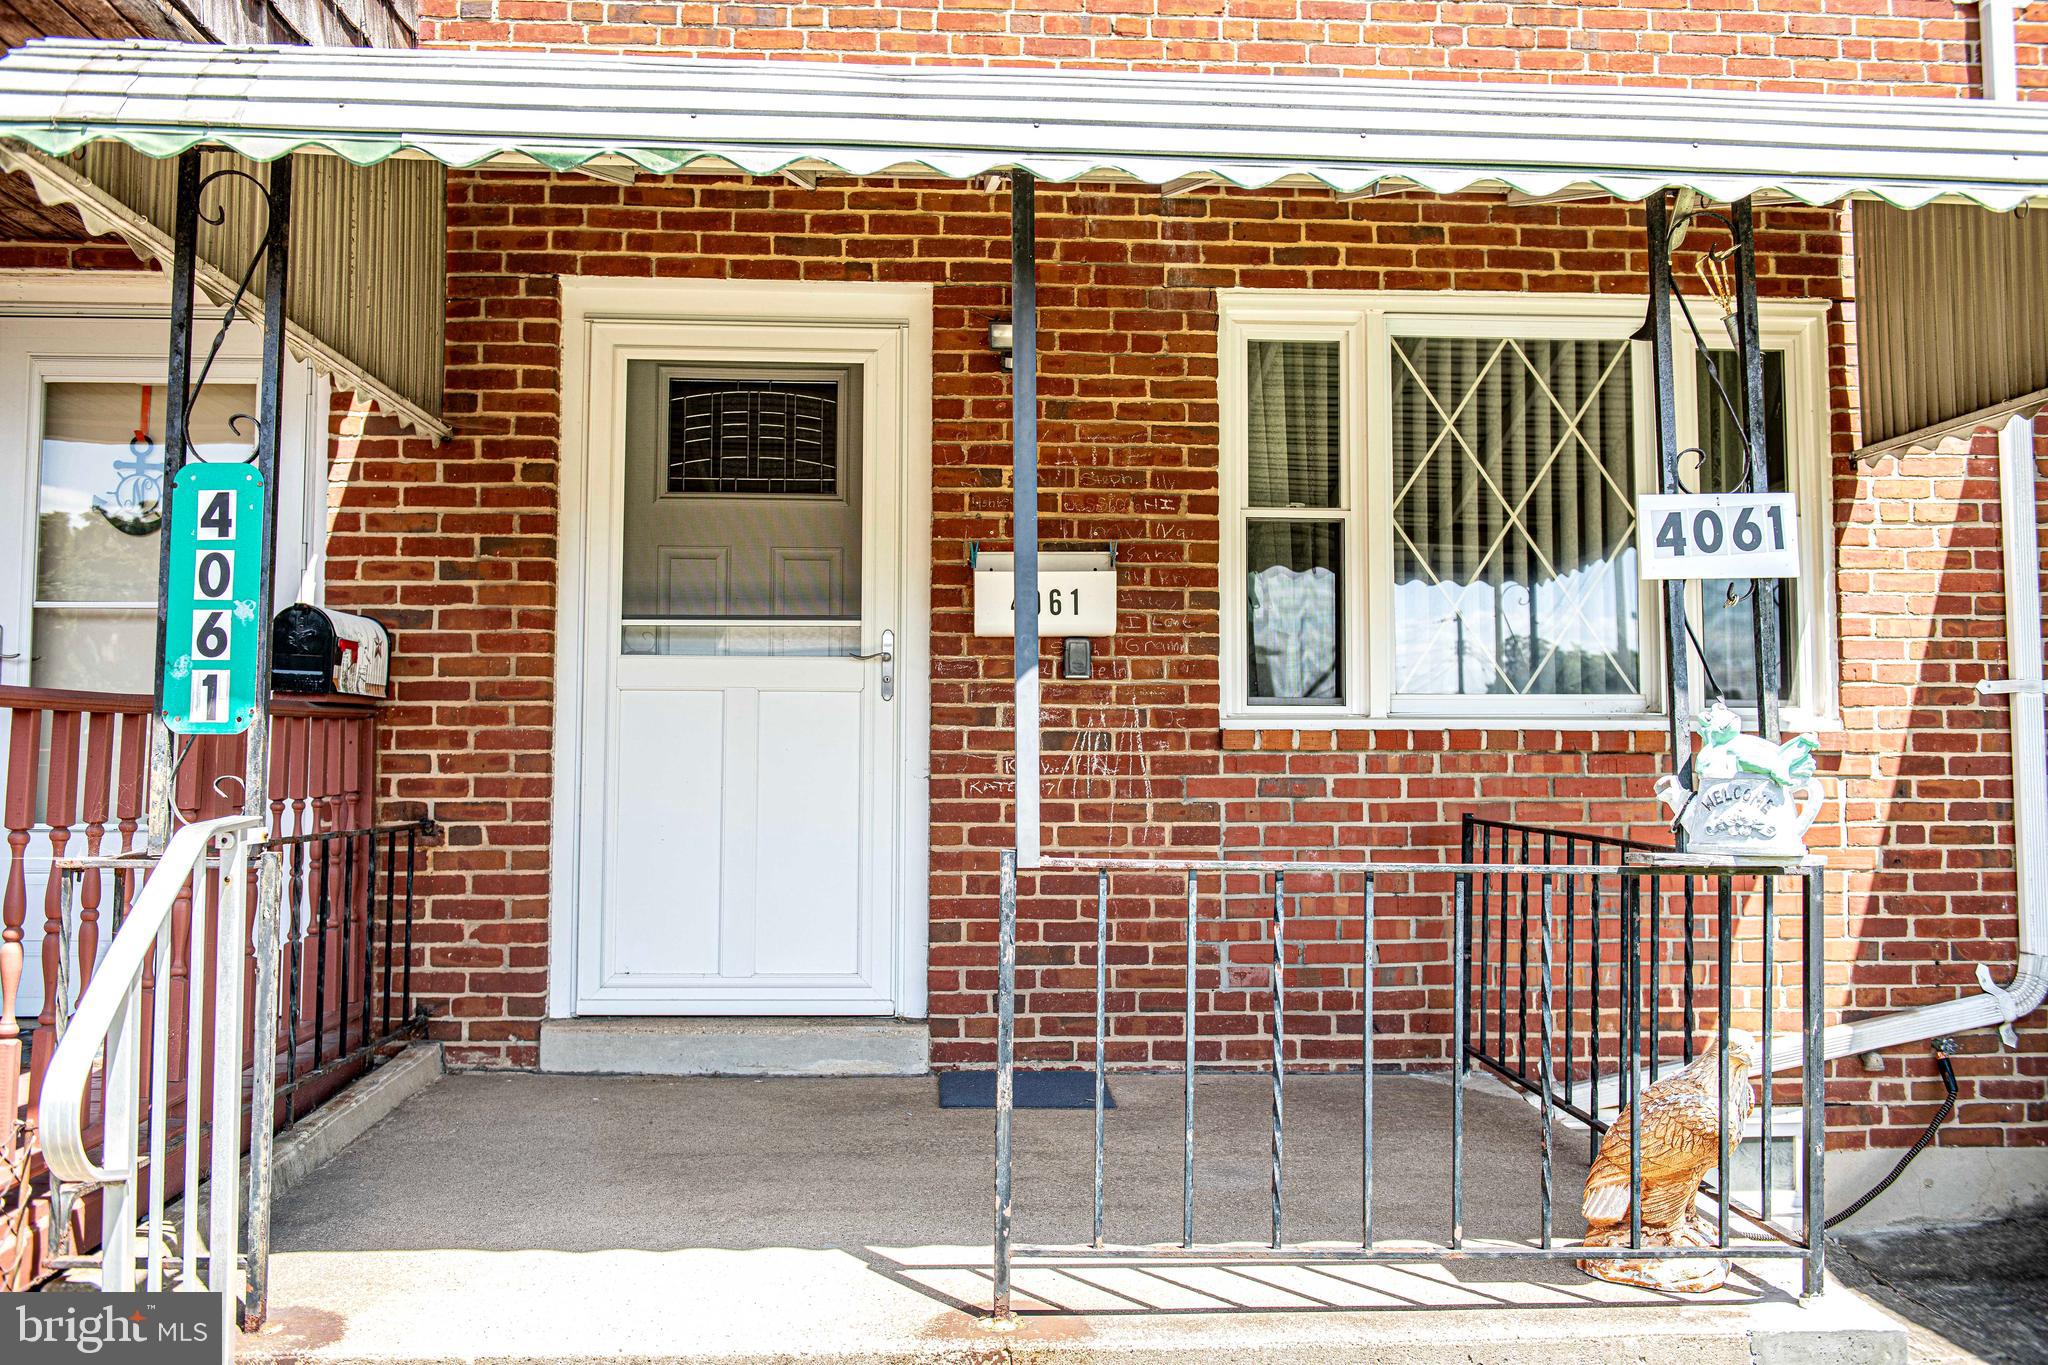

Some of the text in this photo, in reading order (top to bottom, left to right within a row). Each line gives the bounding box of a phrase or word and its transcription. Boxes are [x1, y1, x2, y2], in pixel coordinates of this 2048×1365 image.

[1656, 505, 1785, 557] 4061
[196, 491, 232, 721] 4061
[1011, 588, 1079, 615] 61
[1701, 785, 1774, 815] WELCOME
